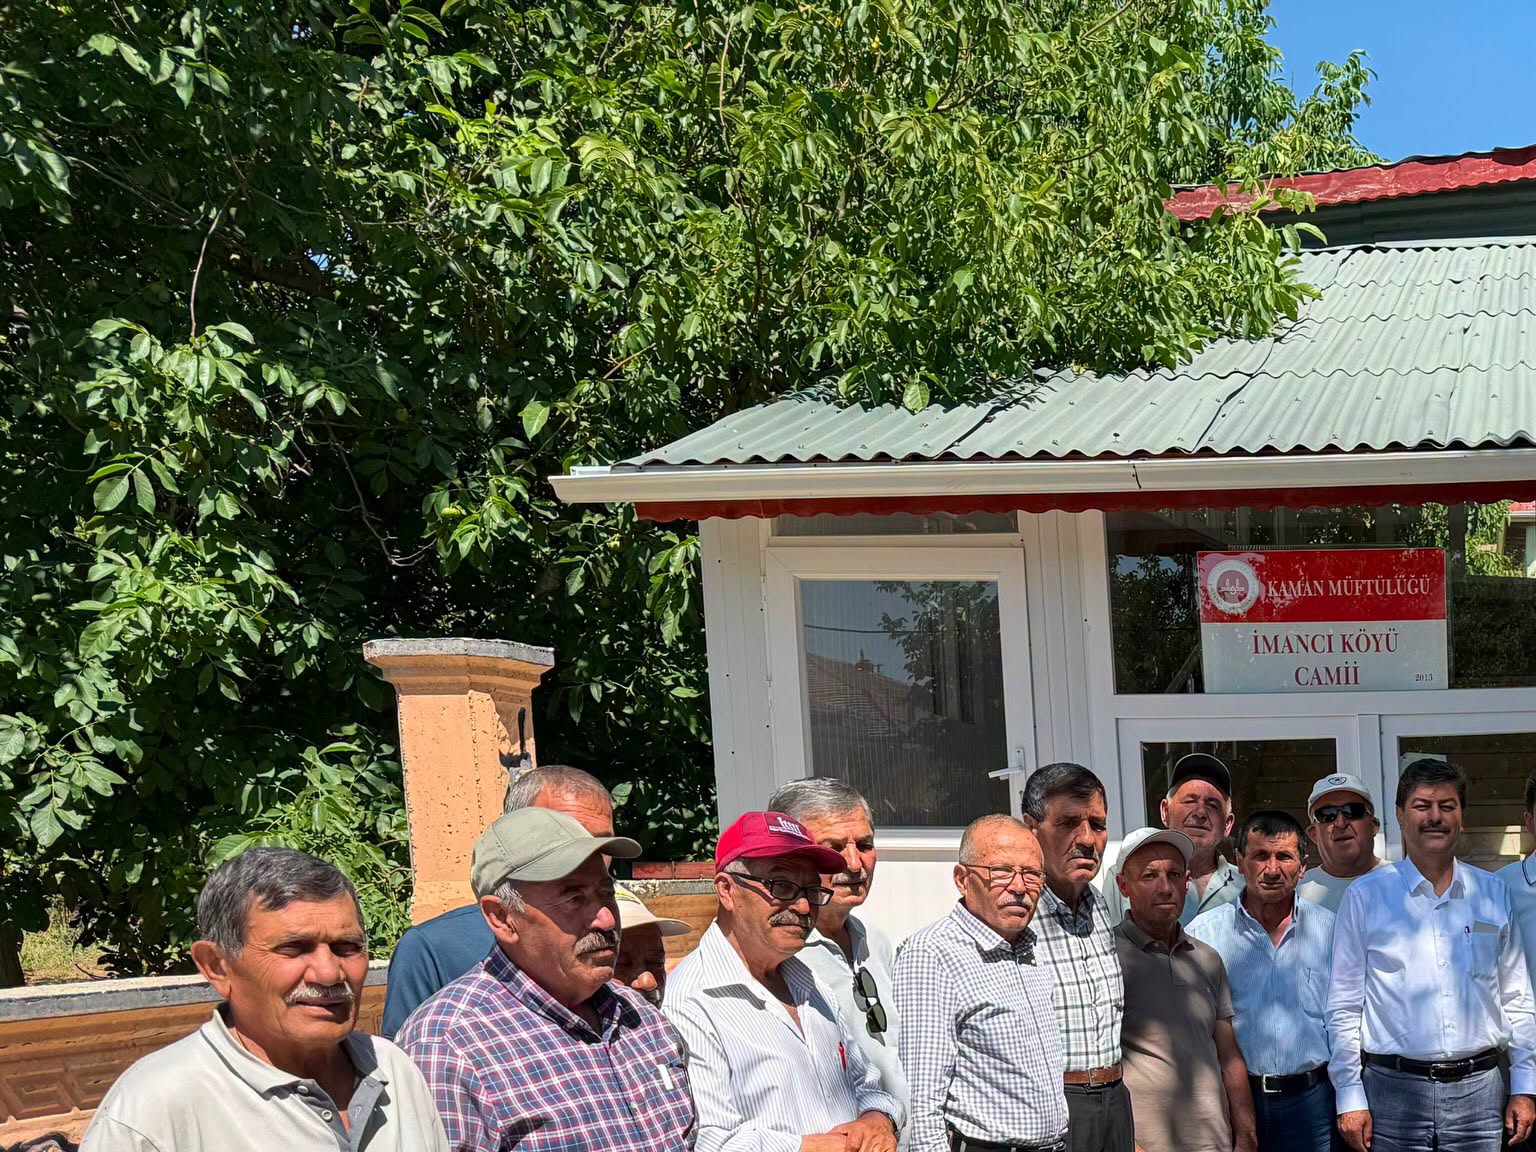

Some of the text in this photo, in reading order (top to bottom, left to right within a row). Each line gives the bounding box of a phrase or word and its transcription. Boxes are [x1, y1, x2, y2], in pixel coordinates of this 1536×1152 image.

[1268, 574, 1431, 597] KAMAN MÜFTÜLÜĞÜ
[1252, 628, 1399, 655] İMANCI KÖYÜ
[1294, 661, 1360, 686] CAMİİ
[1415, 673, 1433, 682] 2013
